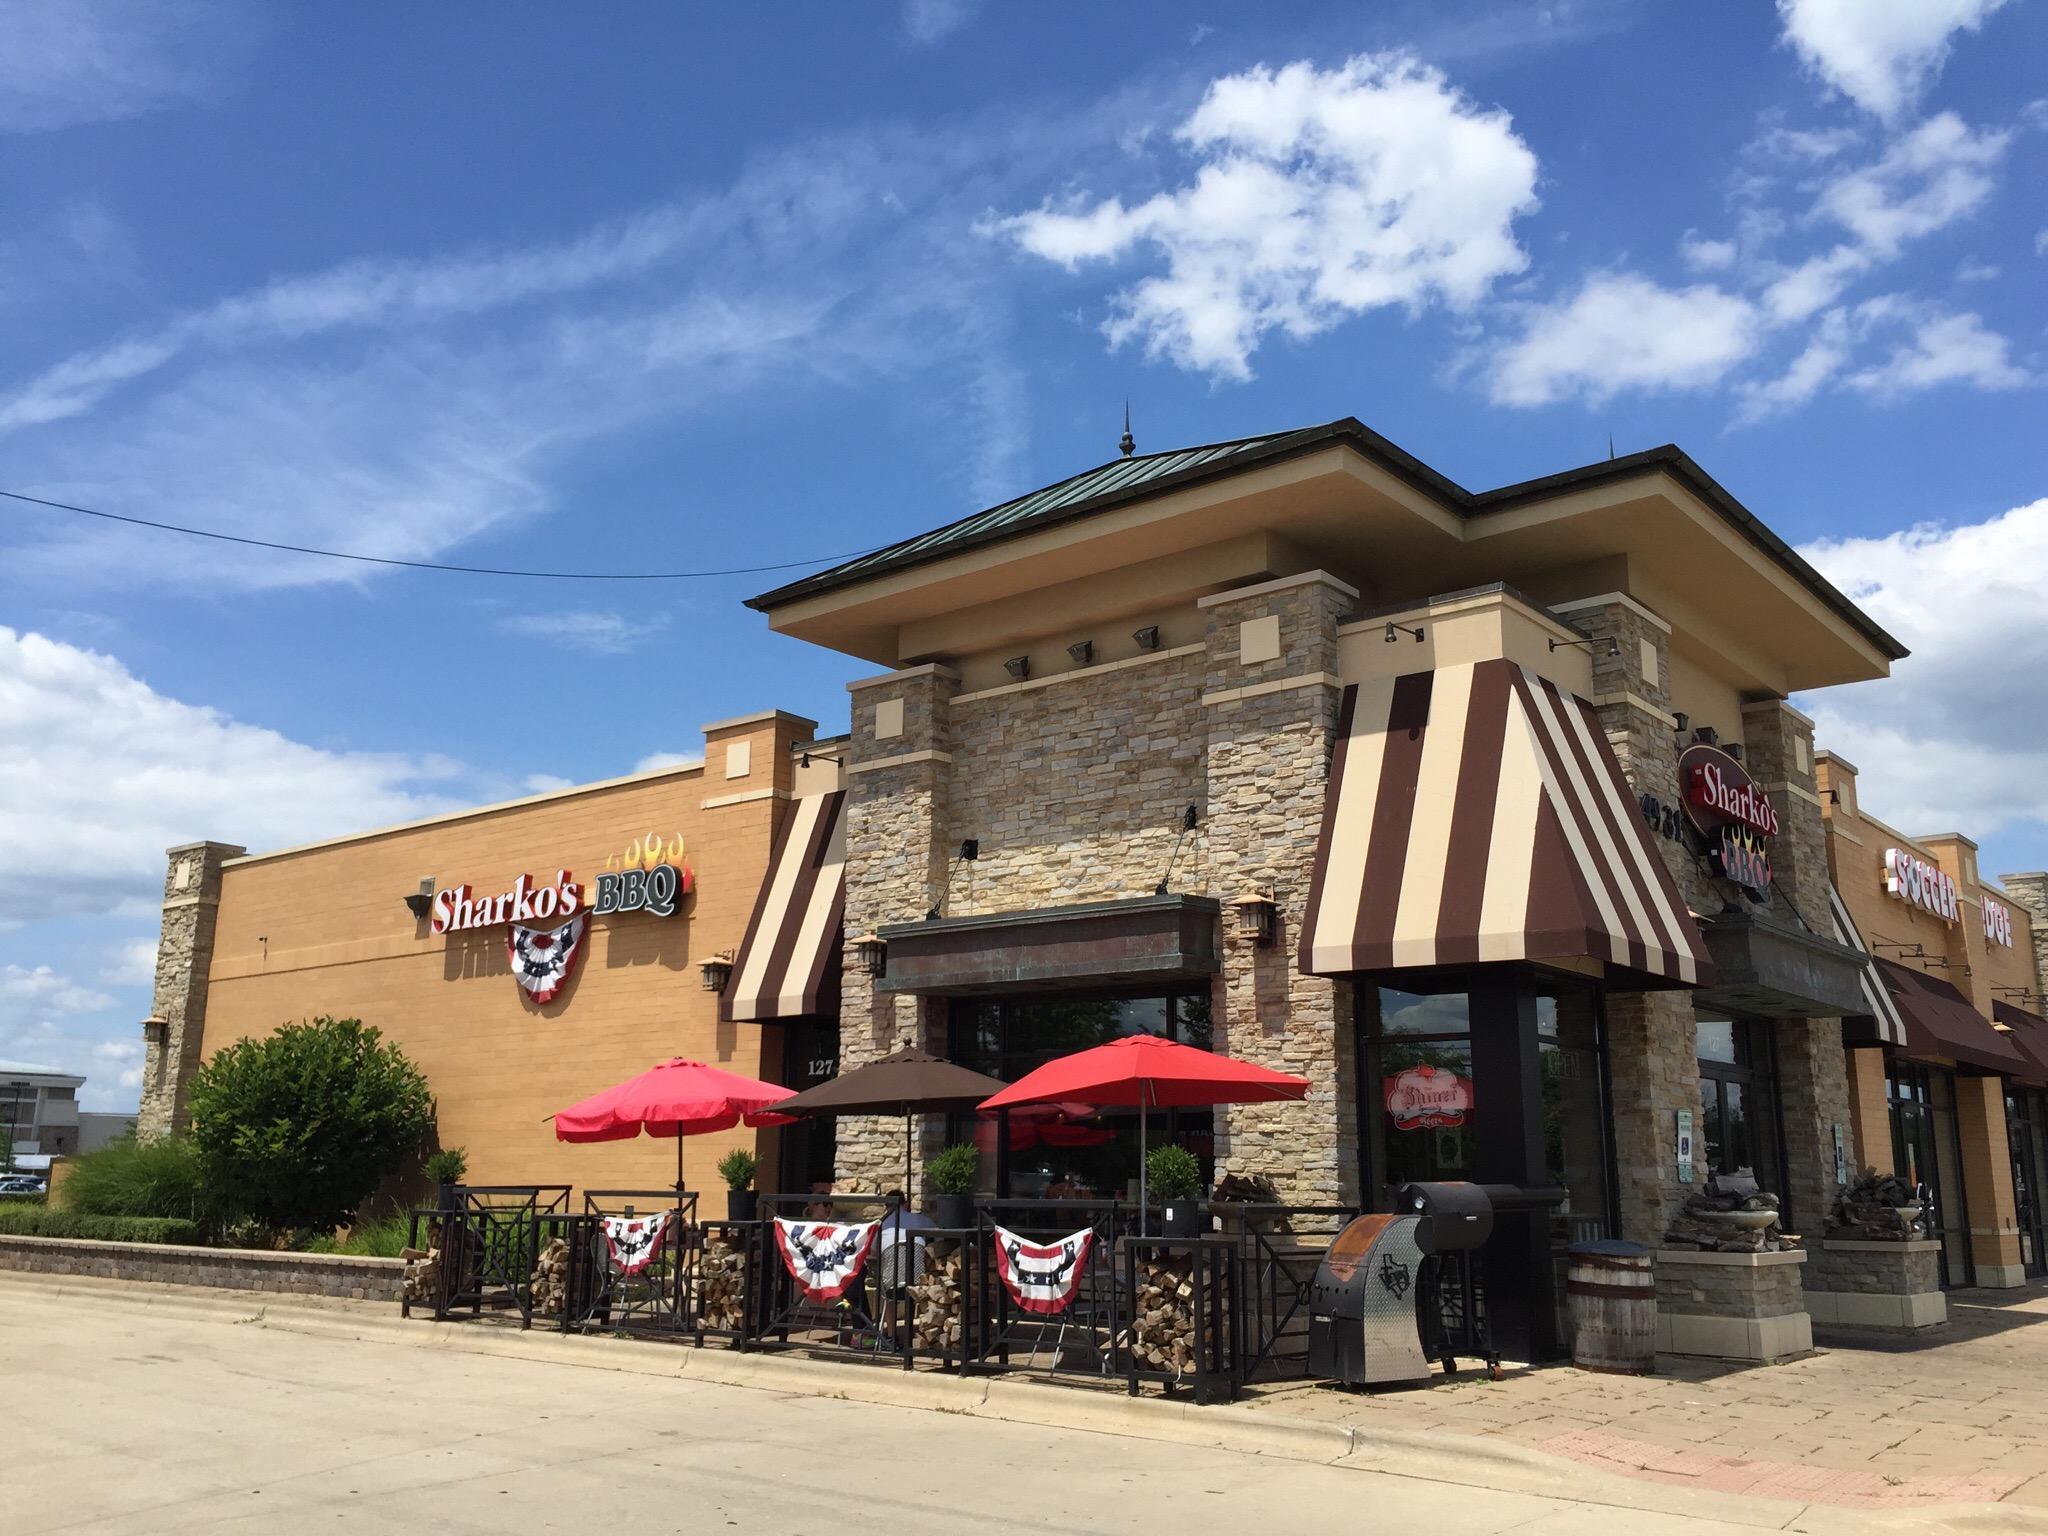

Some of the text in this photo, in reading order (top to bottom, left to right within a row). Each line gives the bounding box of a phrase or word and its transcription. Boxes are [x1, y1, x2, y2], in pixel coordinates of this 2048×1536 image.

[1703, 762, 1779, 836] Sharko's
[431, 864, 680, 934] Sharko's BBQ
[1725, 839, 1772, 901] BBQ
[1888, 848, 1960, 922] SOCCER
[807, 1059, 834, 1075] 127
